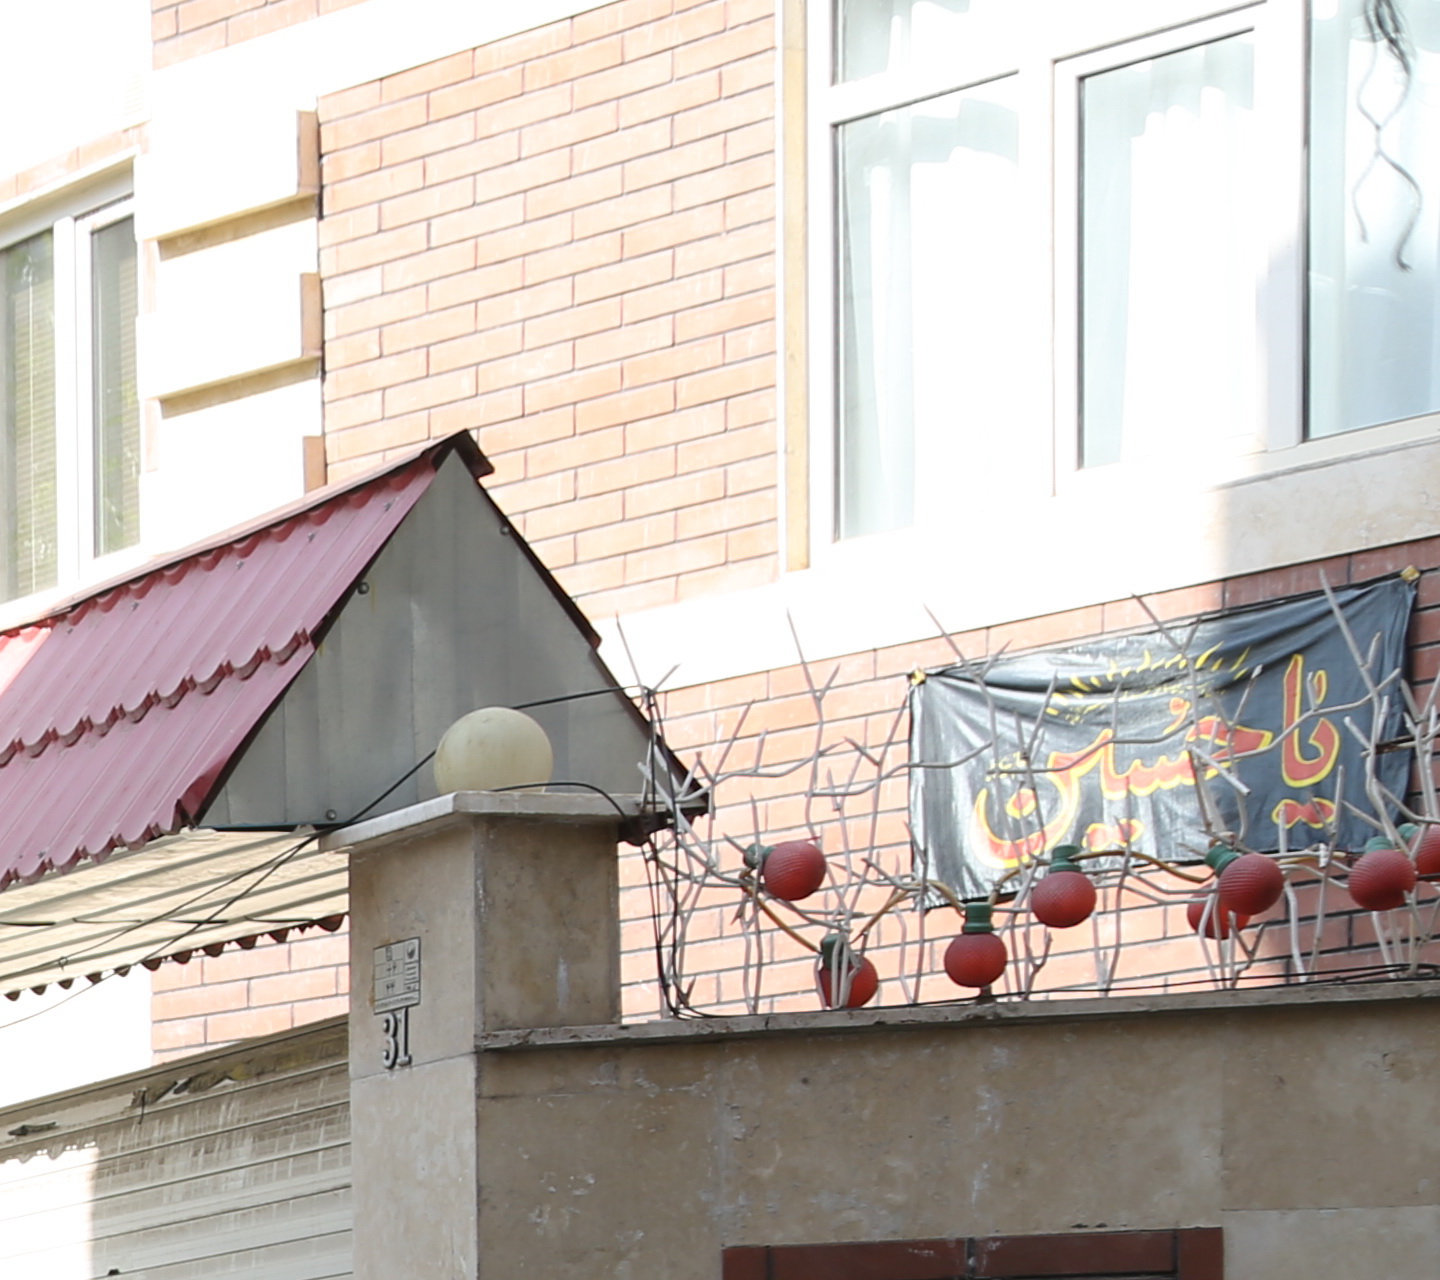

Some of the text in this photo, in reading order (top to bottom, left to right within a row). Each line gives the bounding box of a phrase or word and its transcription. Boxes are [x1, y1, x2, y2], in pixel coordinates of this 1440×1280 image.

[971, 653, 1340, 868] یا حسین
[383, 1007, 412, 1070] 31
